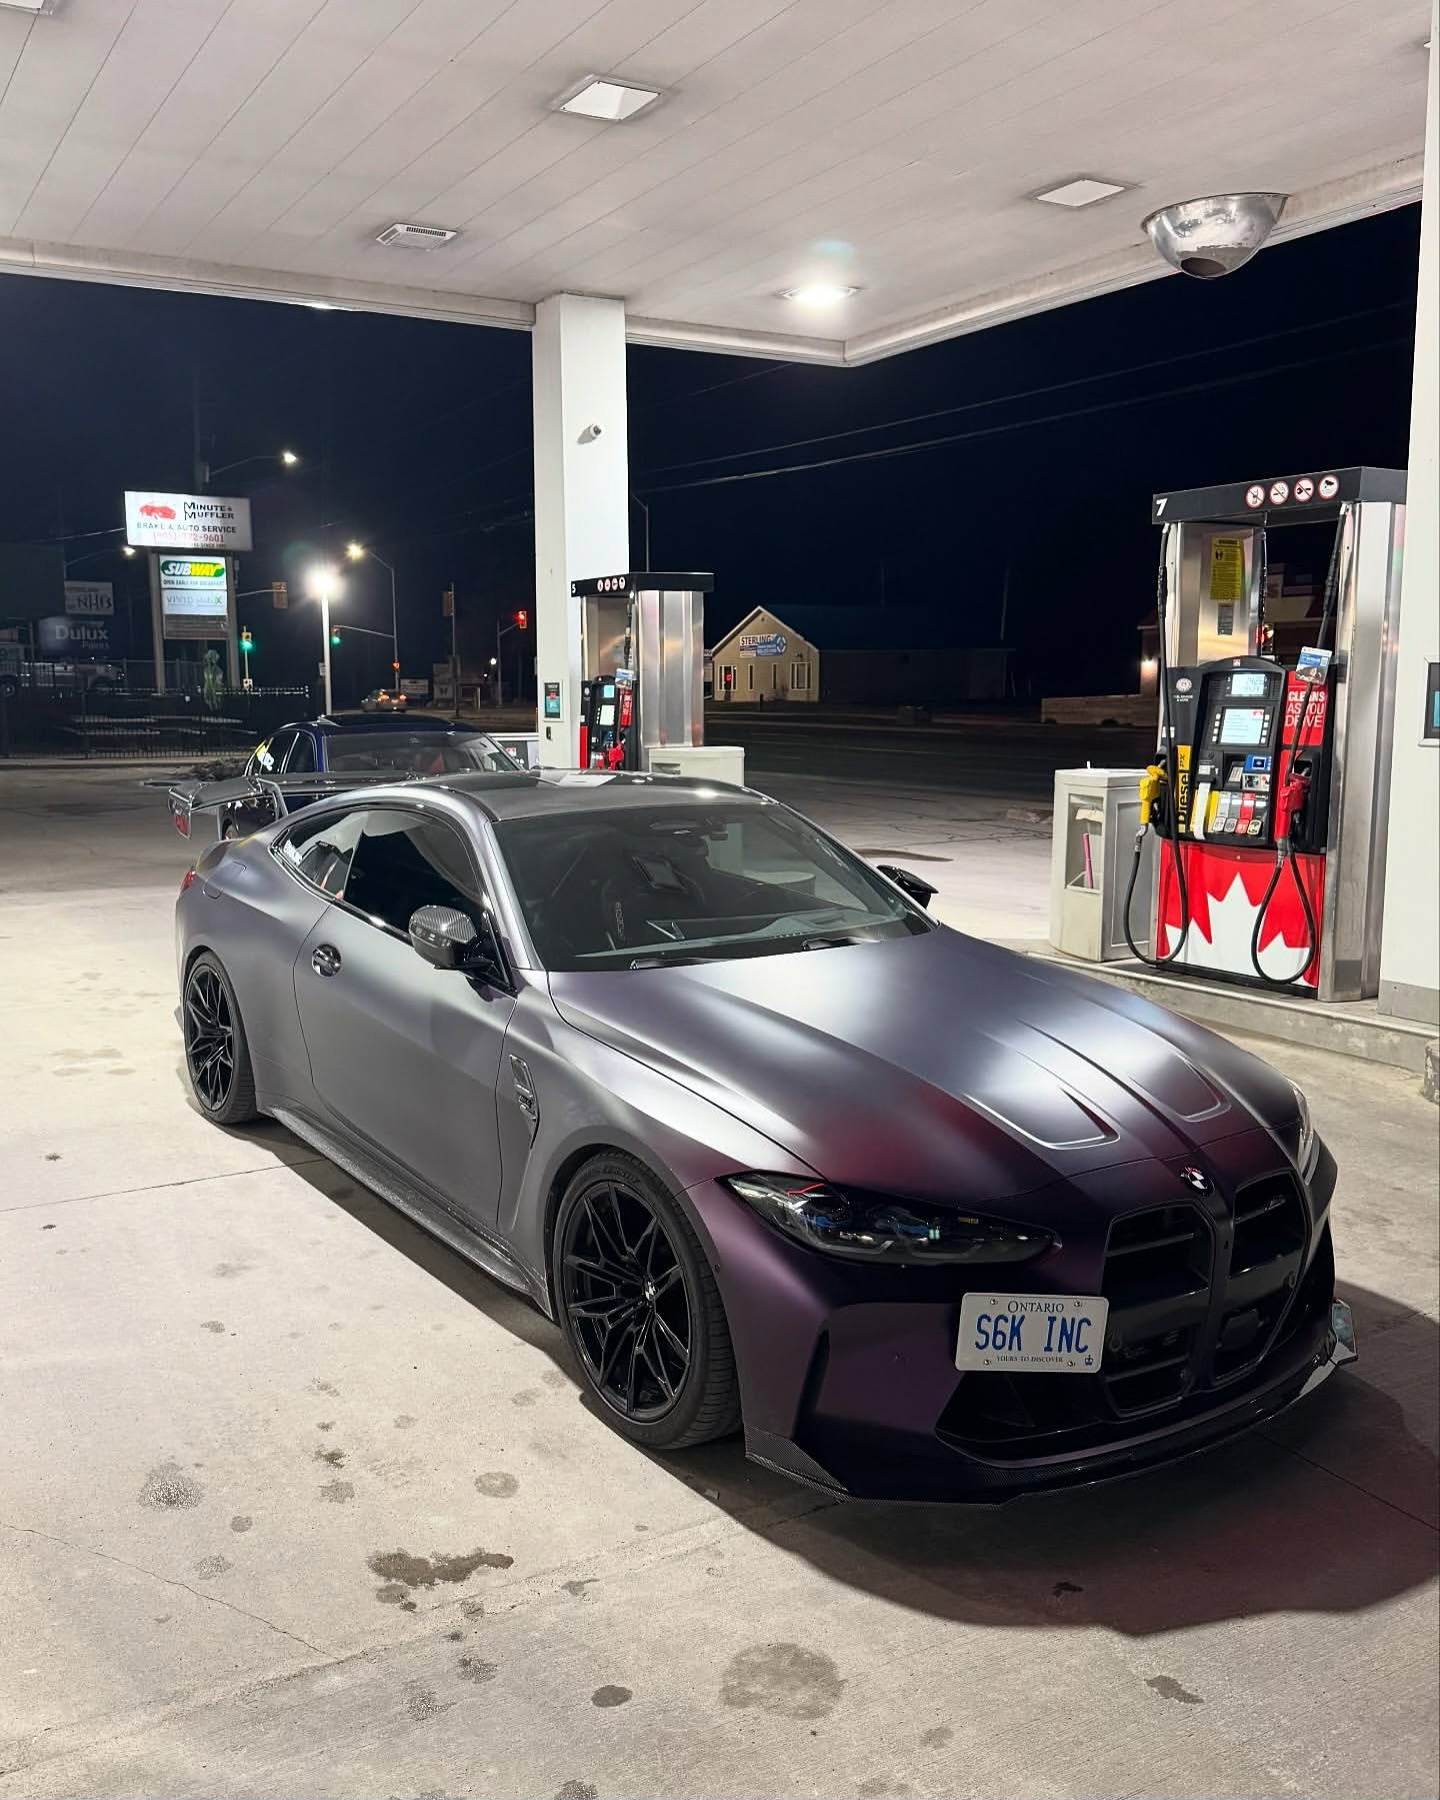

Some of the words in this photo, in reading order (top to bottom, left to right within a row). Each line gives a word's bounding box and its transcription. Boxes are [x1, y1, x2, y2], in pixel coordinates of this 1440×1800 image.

[183, 502, 226, 513] MINUTE
[1156, 498, 1168, 517] 7
[184, 510, 234, 520] MUFFLER
[201, 525, 237, 534] SERVICE
[163, 562, 222, 577] SUBWAY
[571, 583, 577, 594] 5
[55, 624, 108, 640] Dulux
[1287, 702, 1302, 714] AS
[1007, 1300, 1065, 1313] ONTARIO
[974, 1313, 1026, 1351] S6K
[1043, 1315, 1092, 1354] INC
[1031, 1355, 1063, 1363] DISCOVER
